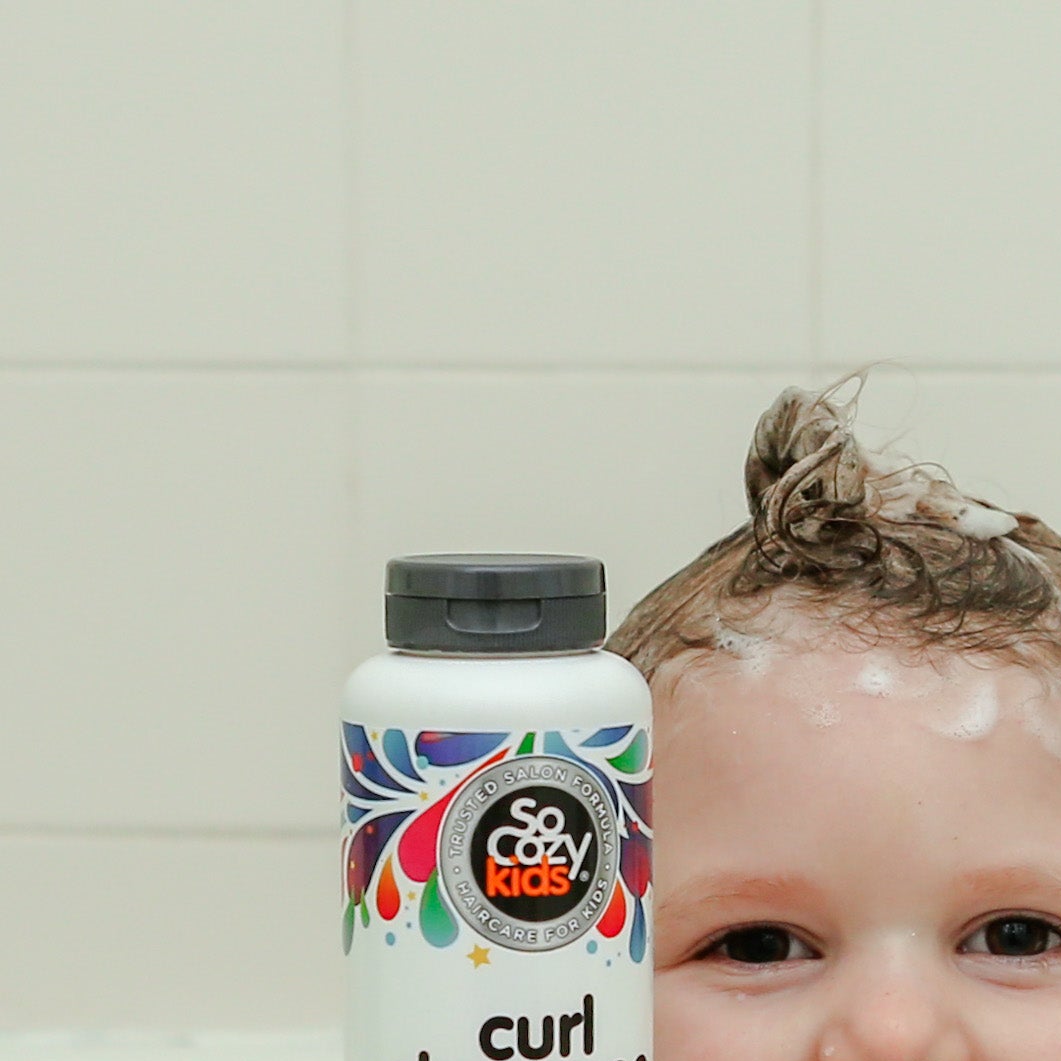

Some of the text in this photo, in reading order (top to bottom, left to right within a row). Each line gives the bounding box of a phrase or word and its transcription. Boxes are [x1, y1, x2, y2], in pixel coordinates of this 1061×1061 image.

[450, 765, 613, 858] TRUSTED SALON FORMULA
[510, 797, 566, 836] So
[485, 854, 571, 898] kids
[457, 879, 608, 943] HAIRCARE FOR KIDS
[479, 993, 594, 1061] curl
